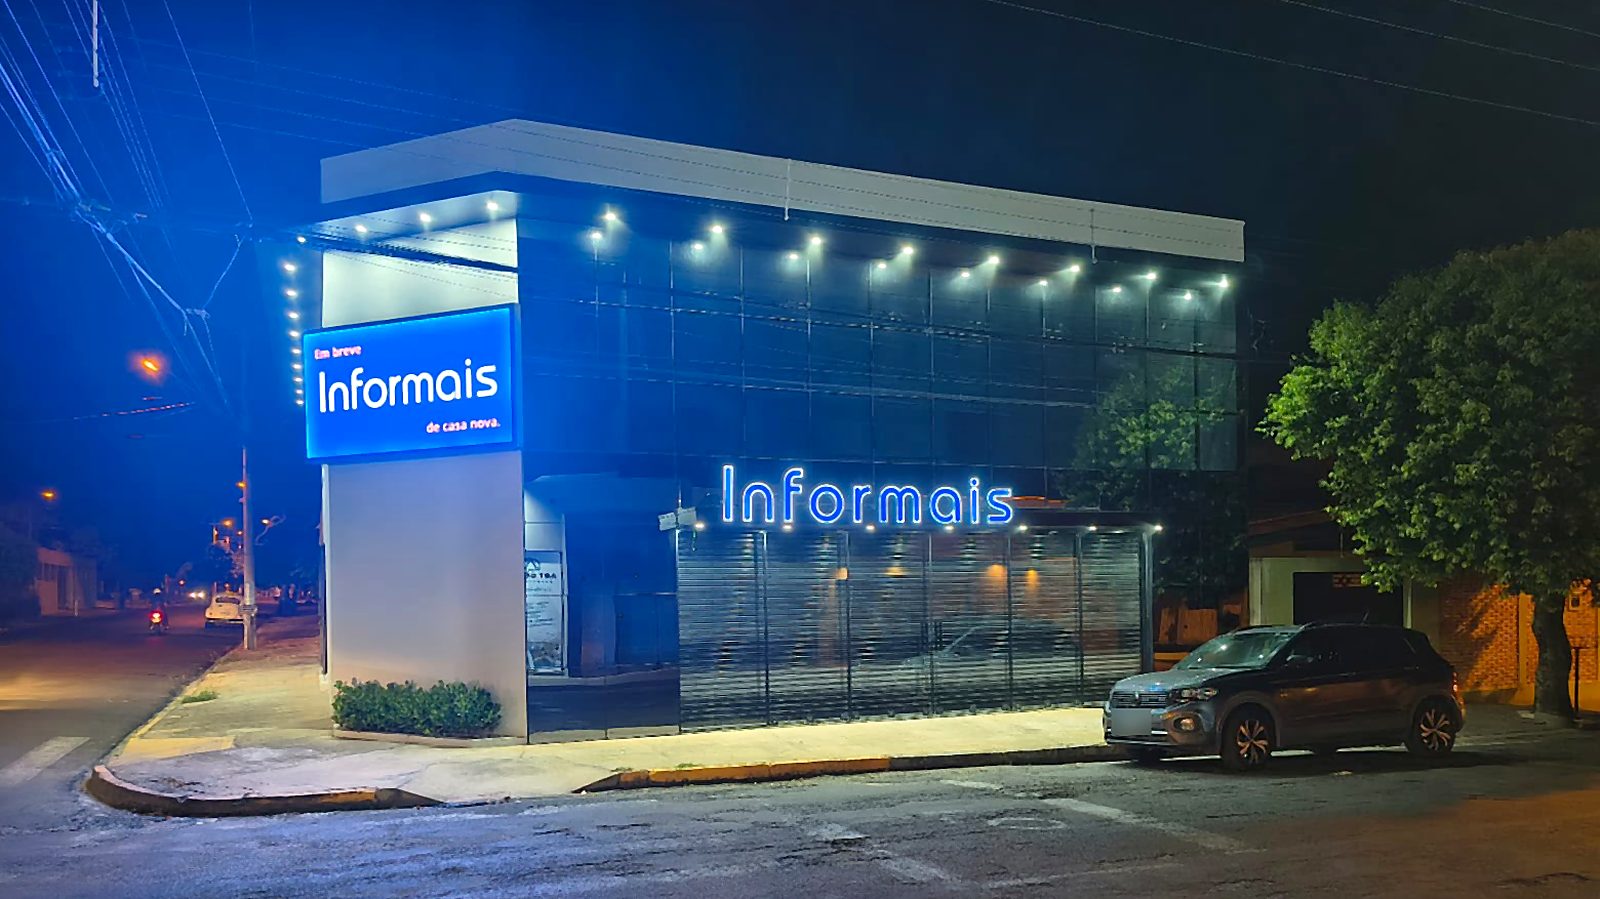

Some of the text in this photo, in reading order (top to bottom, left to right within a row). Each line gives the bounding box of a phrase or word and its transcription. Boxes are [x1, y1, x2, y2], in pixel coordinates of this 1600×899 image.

[314, 345, 362, 360] Em breve
[318, 358, 498, 413] Informais
[426, 417, 501, 433] de casa nova.
[721, 464, 1014, 525] Informais
